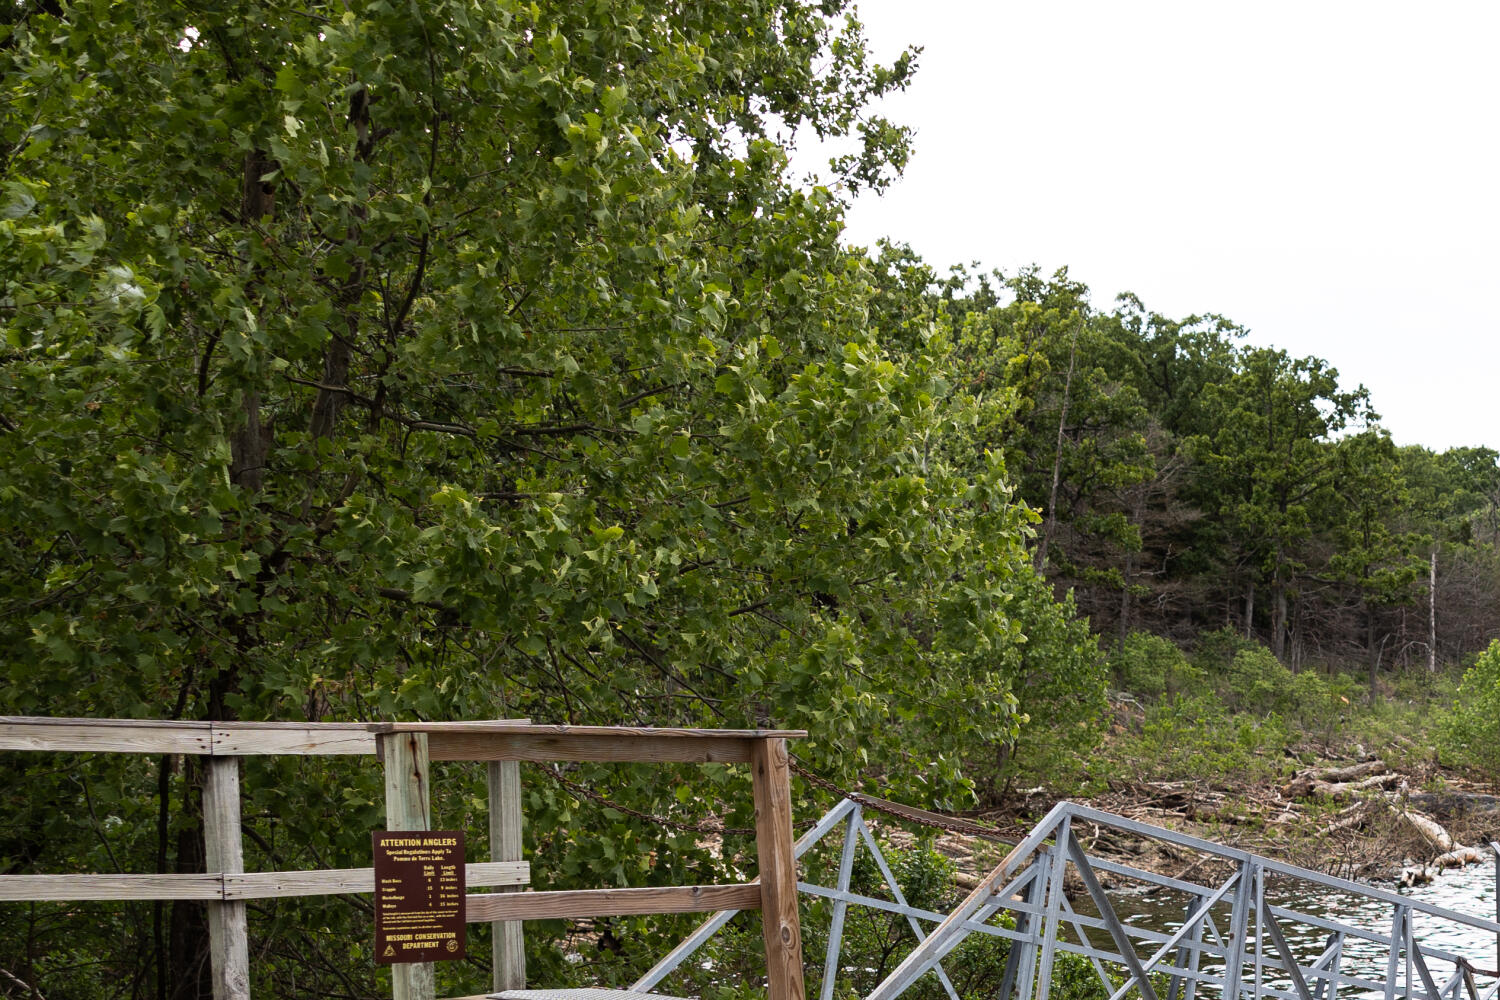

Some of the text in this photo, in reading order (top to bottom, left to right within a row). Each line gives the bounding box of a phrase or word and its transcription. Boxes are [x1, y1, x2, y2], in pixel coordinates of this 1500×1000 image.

[380, 838, 457, 847] ATTENTION ANGLERS
[386, 932, 457, 942] MISSOURI CONSERVATION
[402, 941, 440, 950] DEPARTMENT
